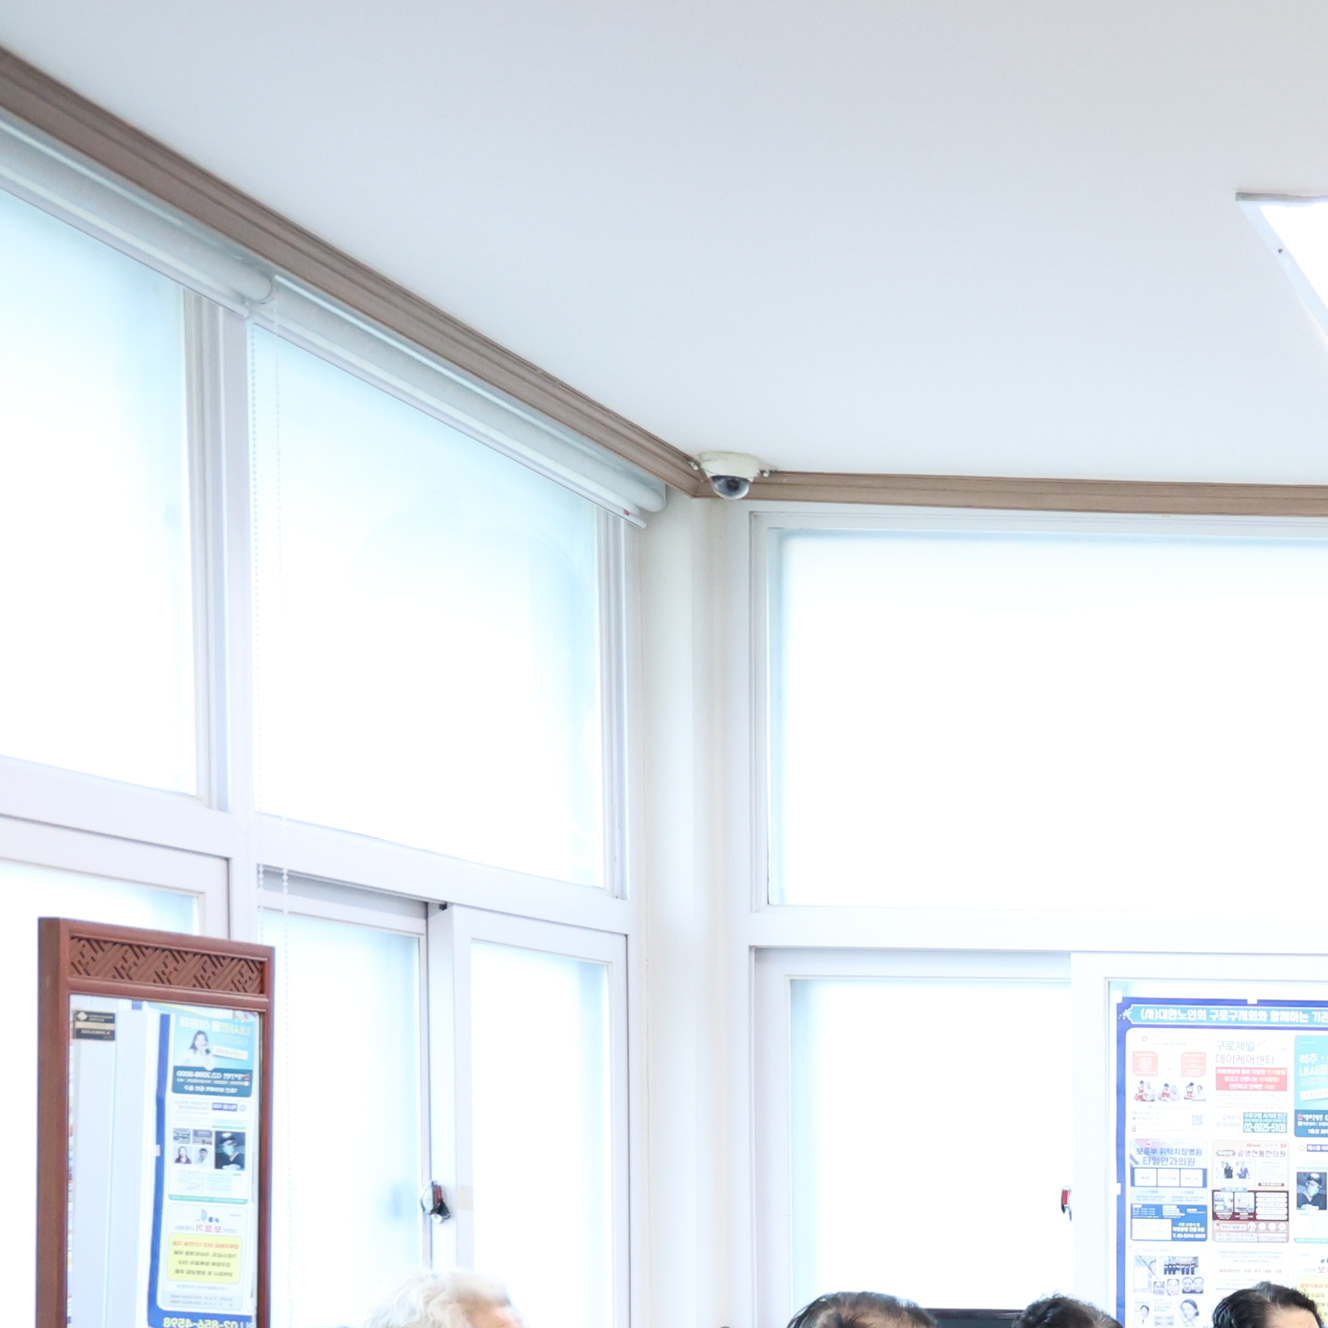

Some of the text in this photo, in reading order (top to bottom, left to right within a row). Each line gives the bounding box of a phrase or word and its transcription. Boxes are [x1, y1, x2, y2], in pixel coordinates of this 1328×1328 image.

[1140, 1008, 1206, 1021] (사)대한노인회
[1209, 1010, 1268, 1022] 구로구지회와
[1270, 1010, 1308, 1022] 함께하는
[1216, 1041, 1255, 1052] 구로제일
[1216, 1054, 1274, 1066] 데이케어센터
[1299, 1054, 1318, 1064] 척추
[1142, 1157, 1195, 1166] 타임안과의원
